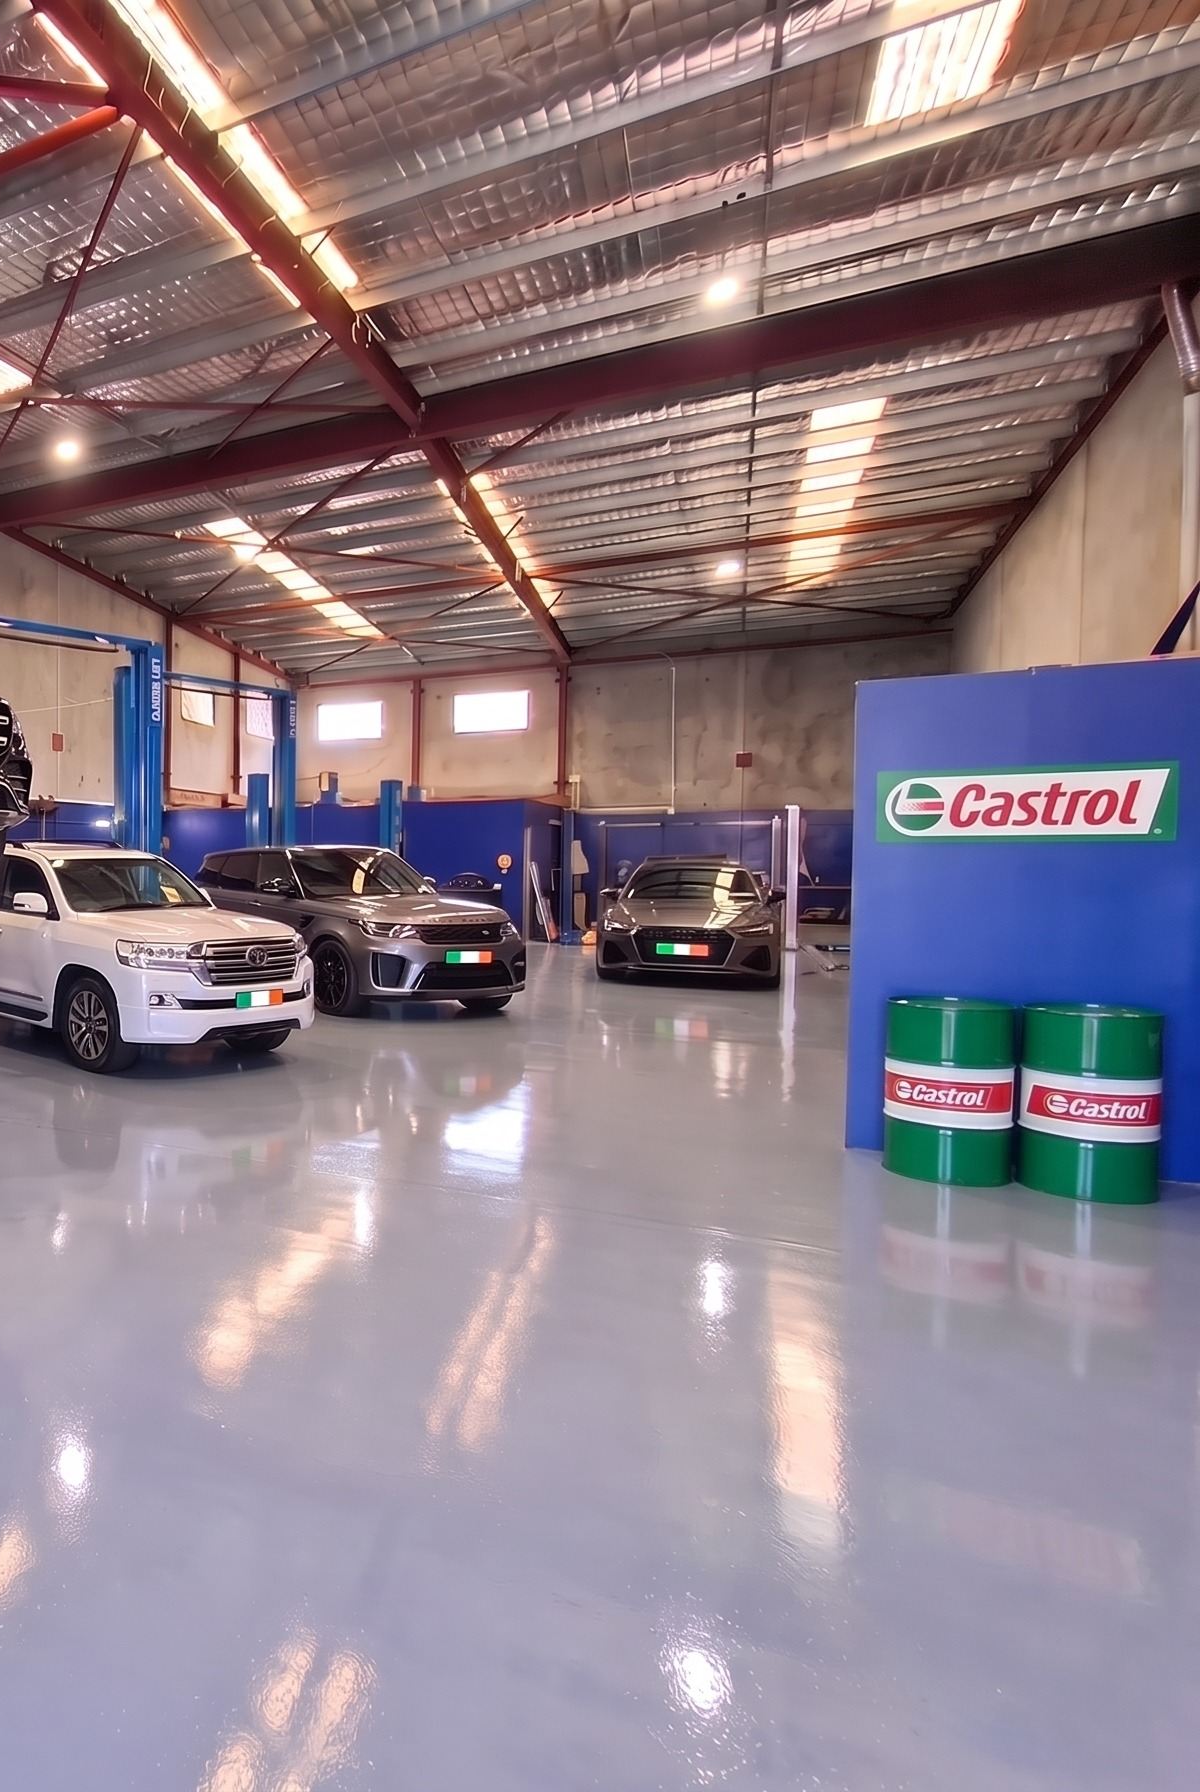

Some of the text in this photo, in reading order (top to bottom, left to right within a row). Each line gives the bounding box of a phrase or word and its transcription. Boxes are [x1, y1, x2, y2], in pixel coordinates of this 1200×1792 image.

[950, 780, 1141, 828] Castrol
[912, 1084, 985, 1106] Castrol
[1069, 1098, 1147, 1120] Castrol
